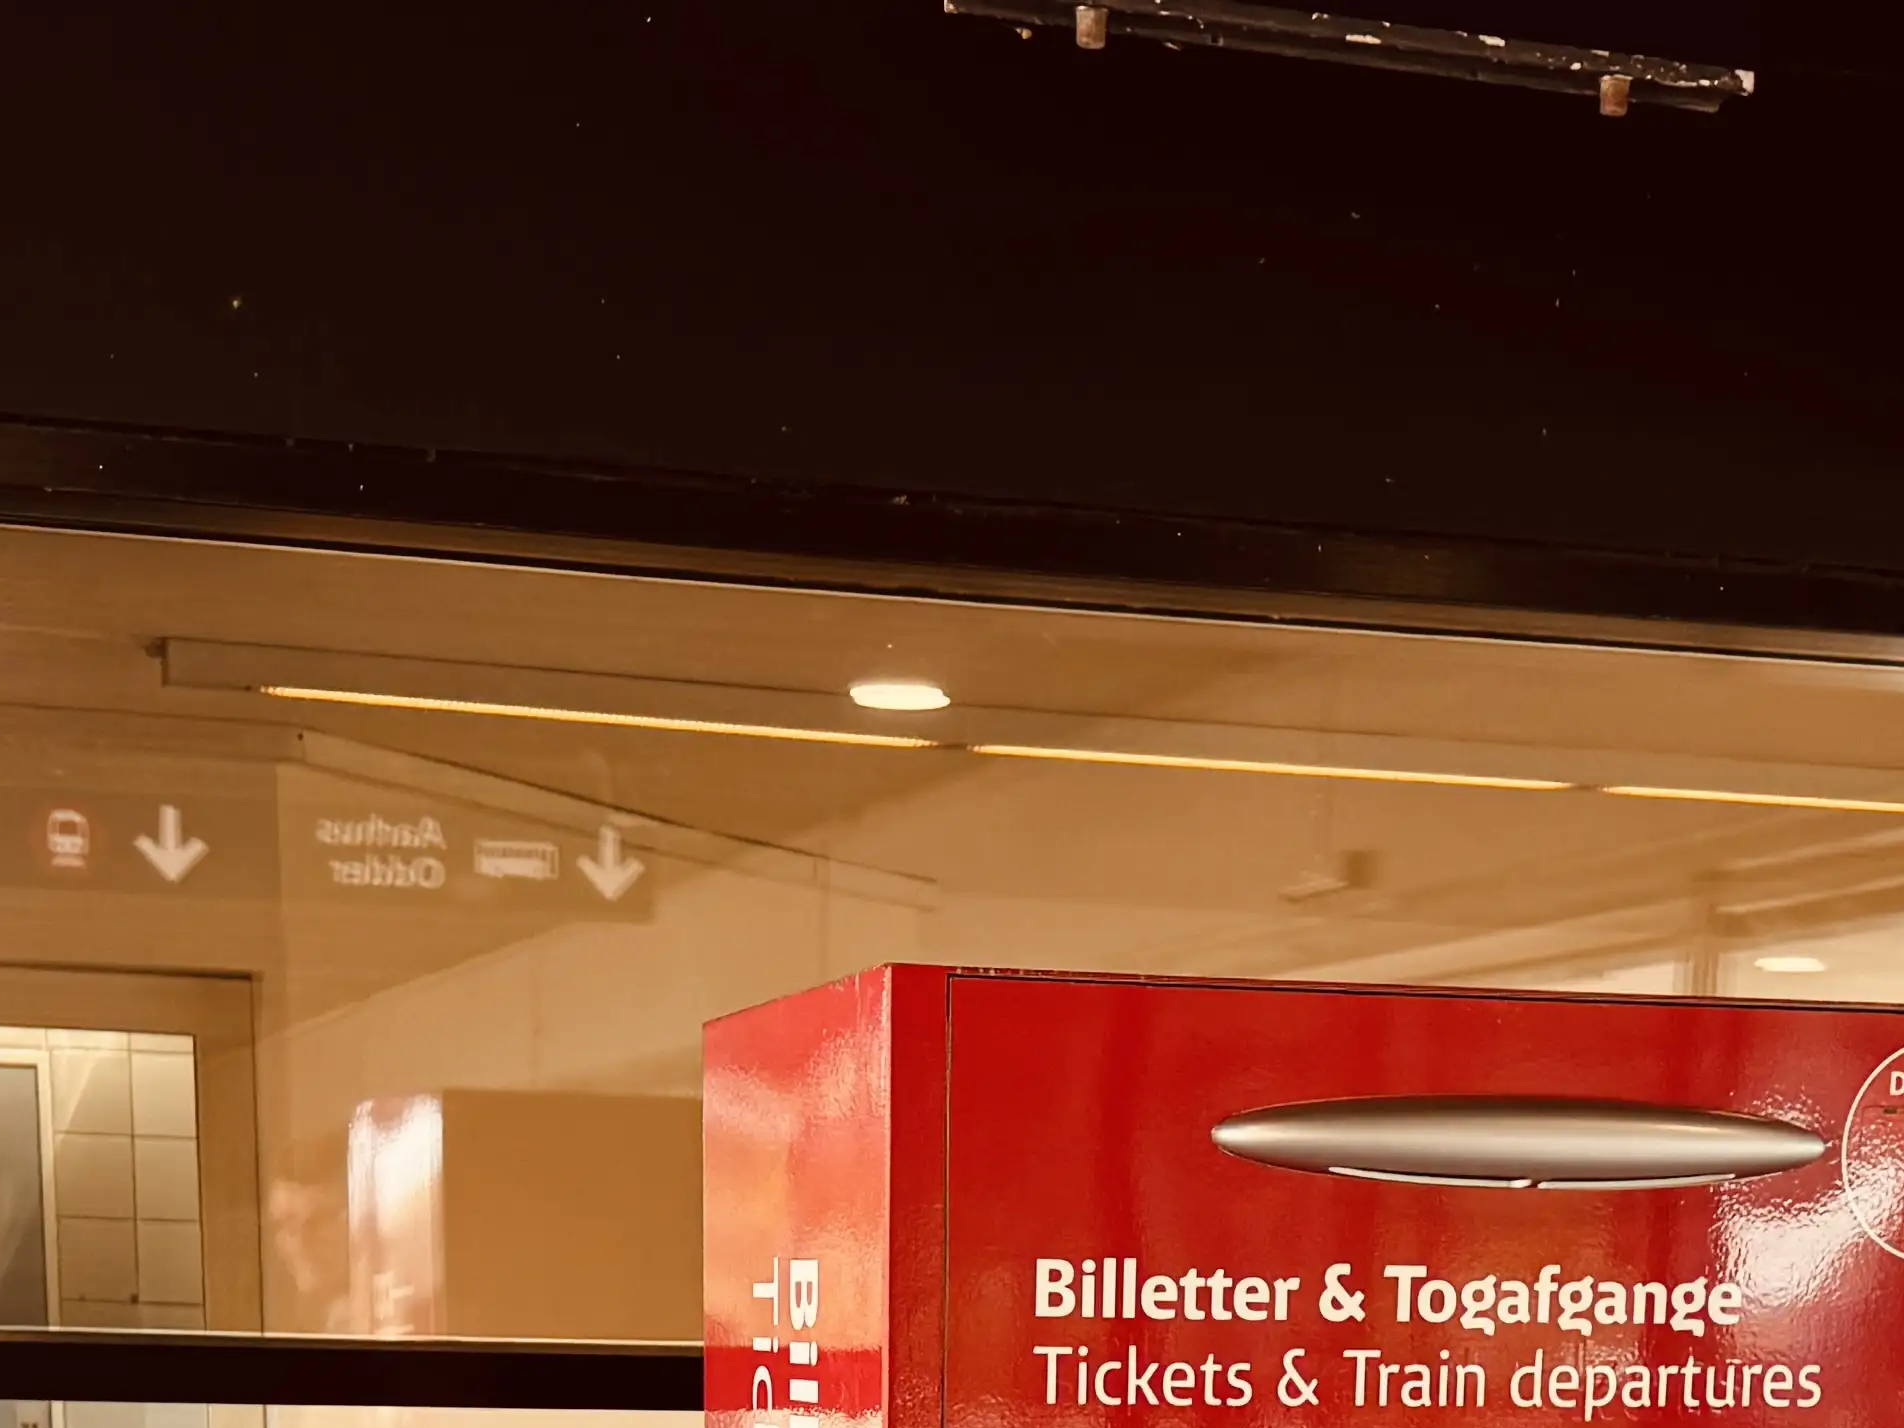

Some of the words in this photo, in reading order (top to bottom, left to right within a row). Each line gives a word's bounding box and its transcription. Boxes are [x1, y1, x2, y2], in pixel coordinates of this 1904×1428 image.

[1035, 1258, 1301, 1321] Billetter
[1319, 1264, 1365, 1321] &
[1383, 1265, 1741, 1337] Togafgange
[1033, 1346, 1252, 1407] Tickets
[1278, 1349, 1319, 1407] &
[1343, 1350, 1486, 1408] Train
[1511, 1349, 1822, 1422] departures
